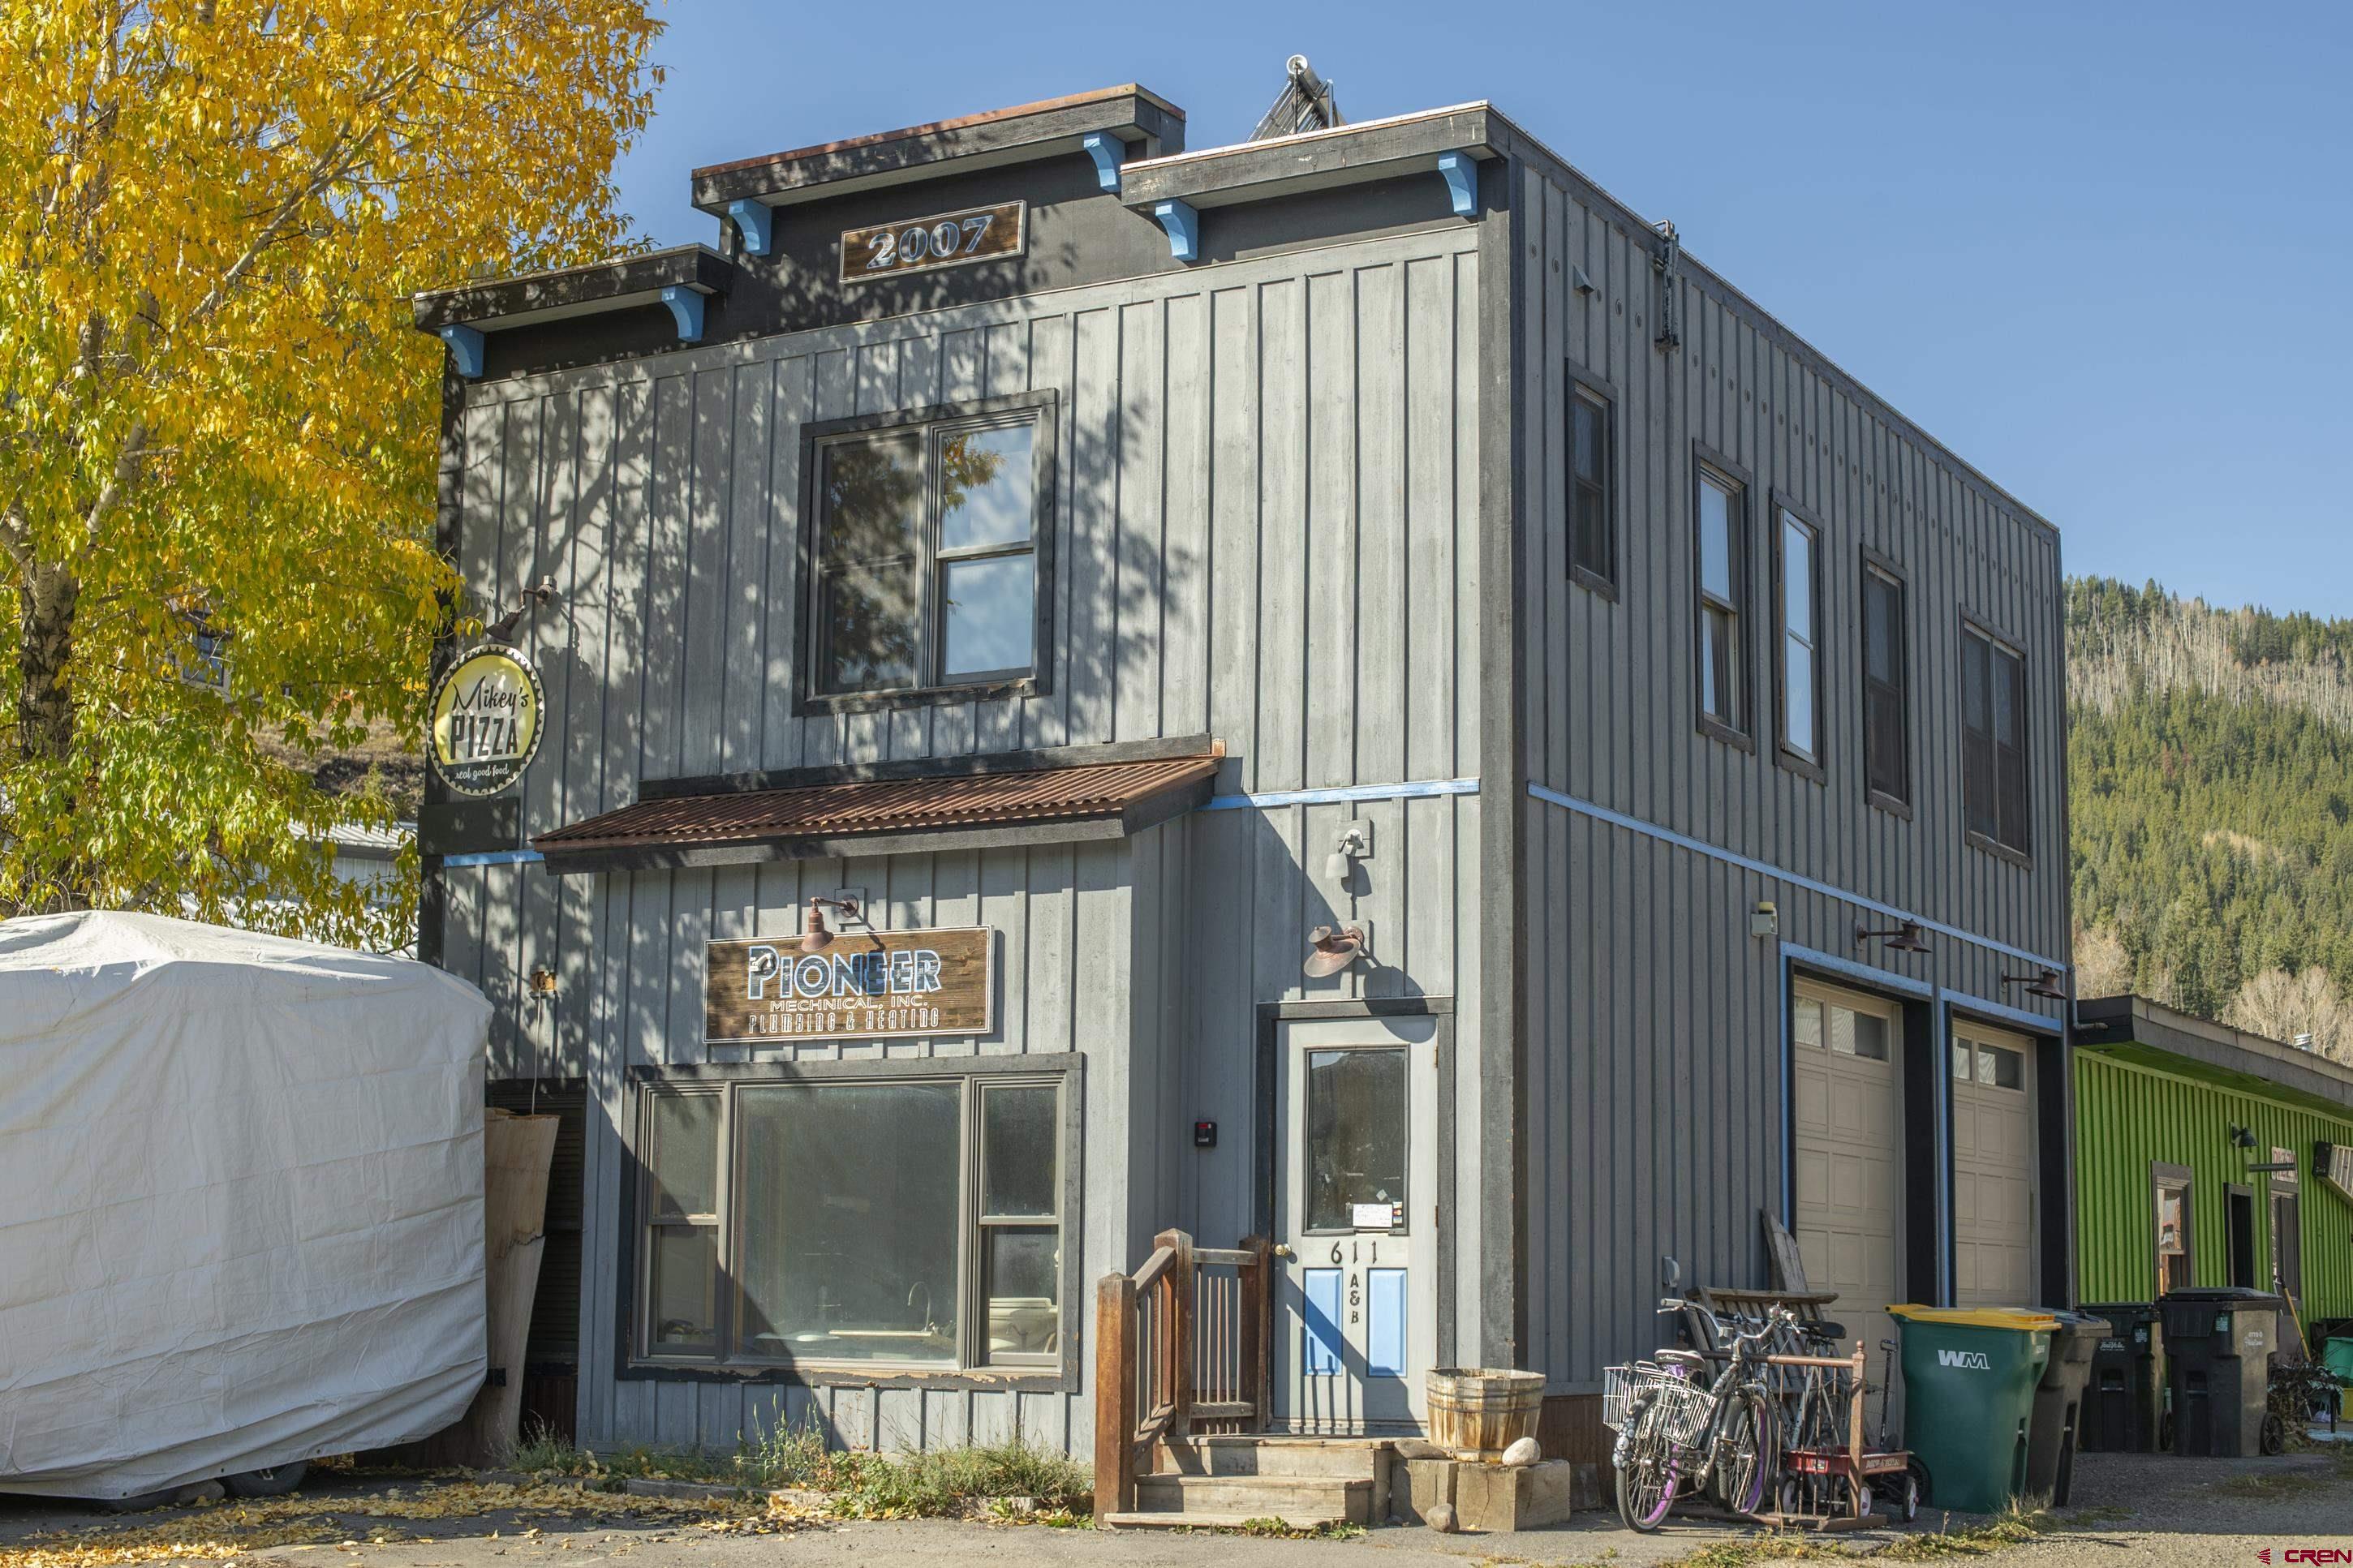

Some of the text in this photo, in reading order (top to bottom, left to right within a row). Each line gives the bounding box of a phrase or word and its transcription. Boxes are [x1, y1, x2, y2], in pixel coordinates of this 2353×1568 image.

[866, 214, 994, 269] 2007
[451, 675, 529, 715] Mikey's
[450, 715, 518, 760] PIZZA
[454, 763, 510, 781] real good food
[747, 945, 942, 1000] PIONEER
[890, 994, 929, 1008] INC.
[748, 1007, 940, 1034] PLUMBING & HEATING
[1331, 1240, 1378, 1265] 611
[1938, 1349, 1990, 1369] WM
